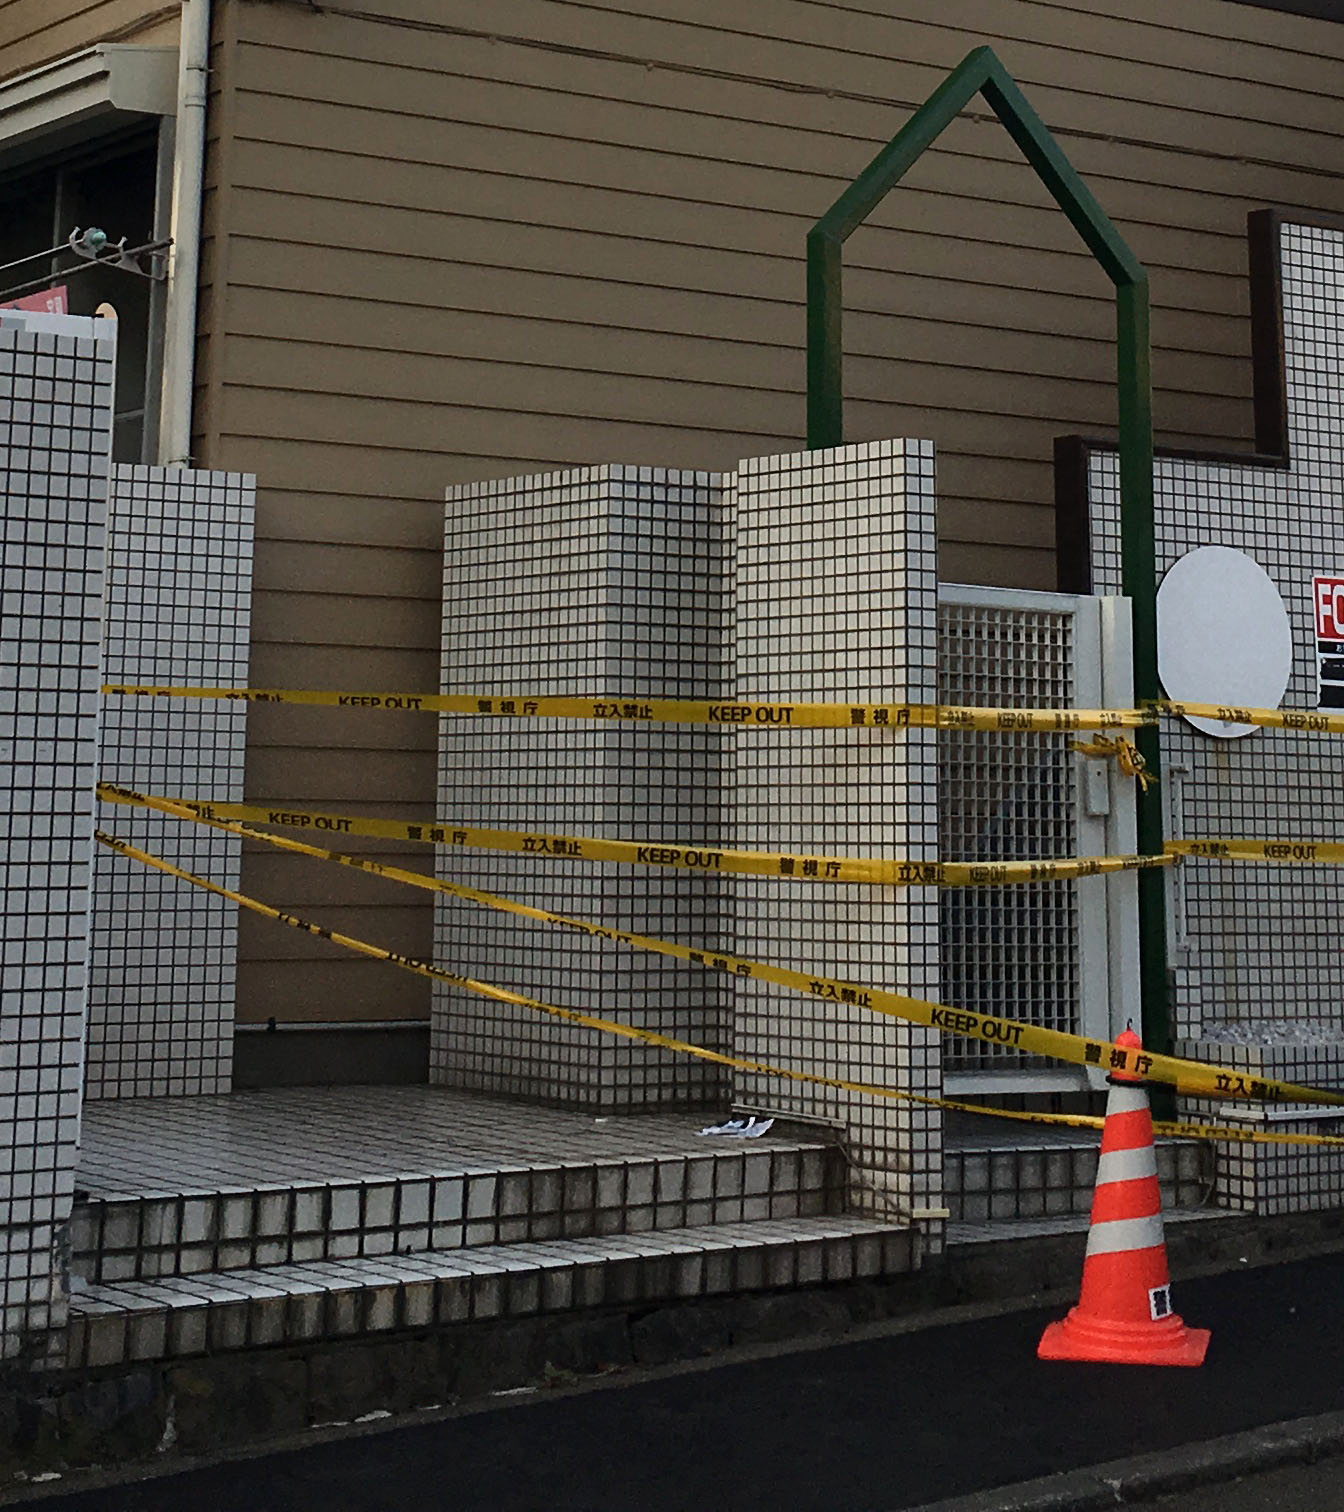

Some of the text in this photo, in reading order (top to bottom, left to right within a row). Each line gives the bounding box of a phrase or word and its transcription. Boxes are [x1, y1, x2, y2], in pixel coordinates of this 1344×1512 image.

[477, 699, 539, 716] 警視庁
[592, 702, 654, 721] 立入禁止
[708, 706, 752, 722] KEEP
[755, 706, 795, 724] OUT
[850, 707, 911, 726] 警視庁
[1282, 713, 1307, 728] KEEP
[1308, 715, 1330, 731] OUT
[268, 811, 311, 827] KEEP
[314, 816, 353, 832] OUT
[407, 826, 468, 845] 警視庁
[522, 837, 582, 856] 立入禁止
[636, 846, 681, 864] KEEP
[683, 851, 723, 868] OUT
[779, 857, 842, 878] 警視庁
[898, 865, 946, 883] 立入禁止
[1263, 844, 1291, 858] KEEP
[1292, 845, 1317, 860] OUT
[808, 980, 873, 1010] 立入禁止
[931, 1008, 978, 1034] KEEP
[981, 1019, 1025, 1044] OUT
[1084, 1042, 1153, 1075] 警視庁
